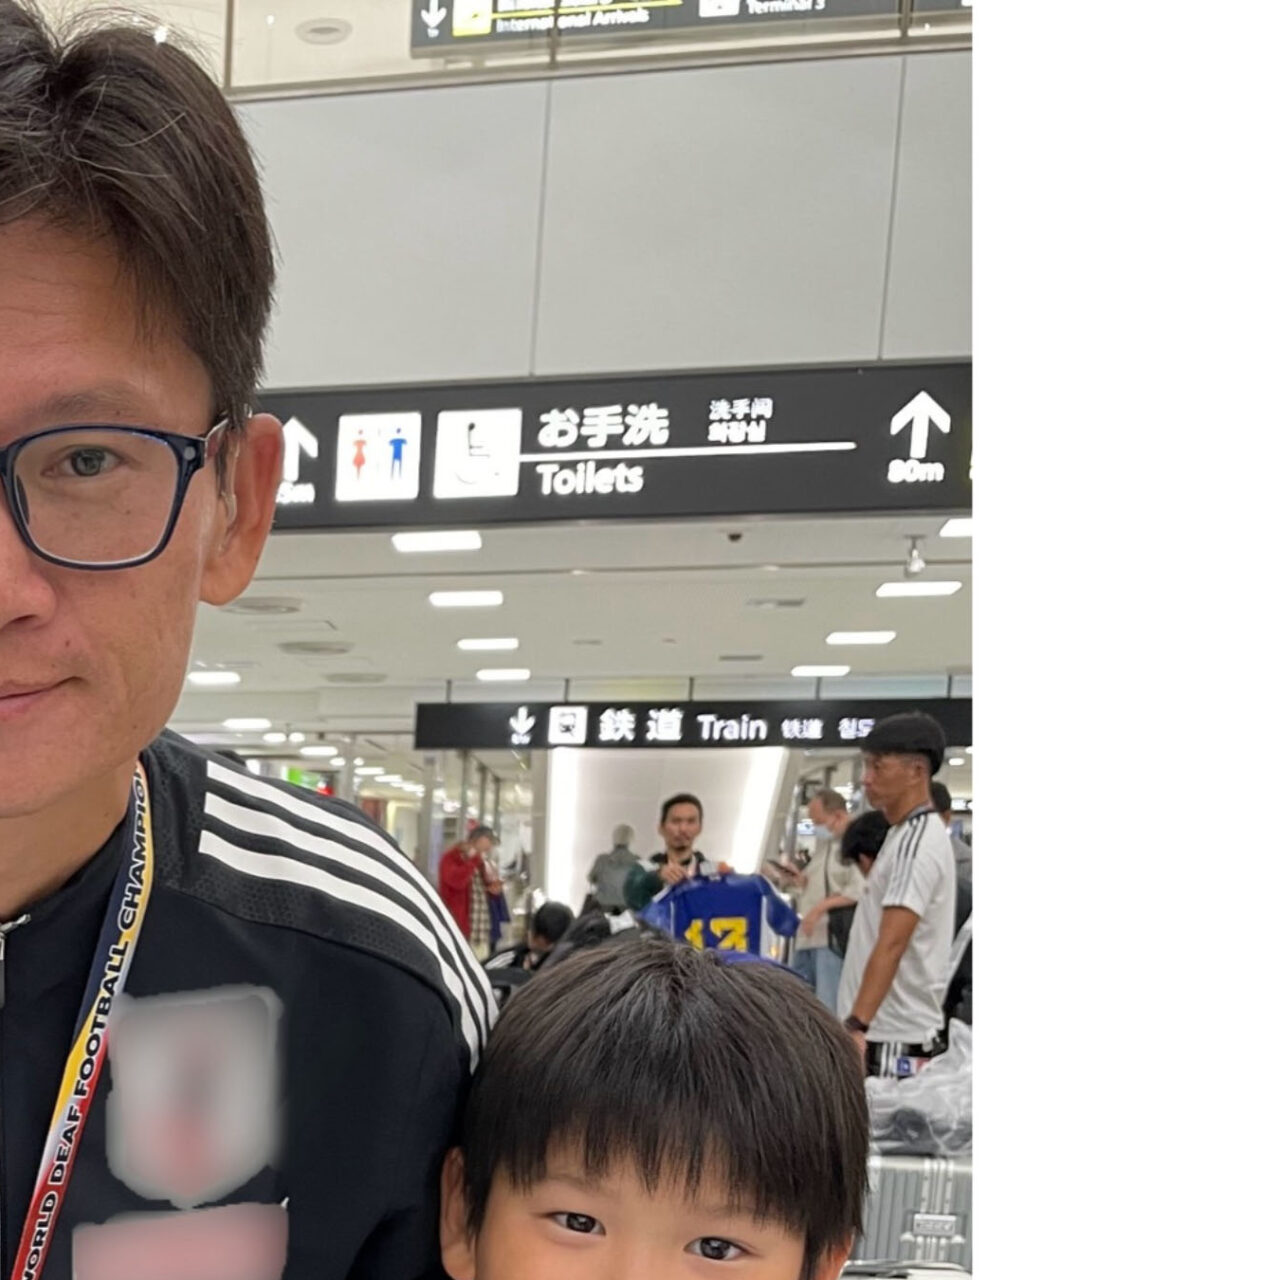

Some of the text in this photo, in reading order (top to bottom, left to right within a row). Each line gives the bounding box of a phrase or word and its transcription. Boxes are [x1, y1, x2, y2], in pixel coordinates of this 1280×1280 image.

[537, 403, 670, 448] お手洗
[536, 461, 644, 496] Toilets
[697, 714, 767, 742] Train
[48, 1105, 83, 1184] DEAF
[73, 937, 131, 1099] FOOTBALL
[117, 770, 148, 931] CHAMPIO
